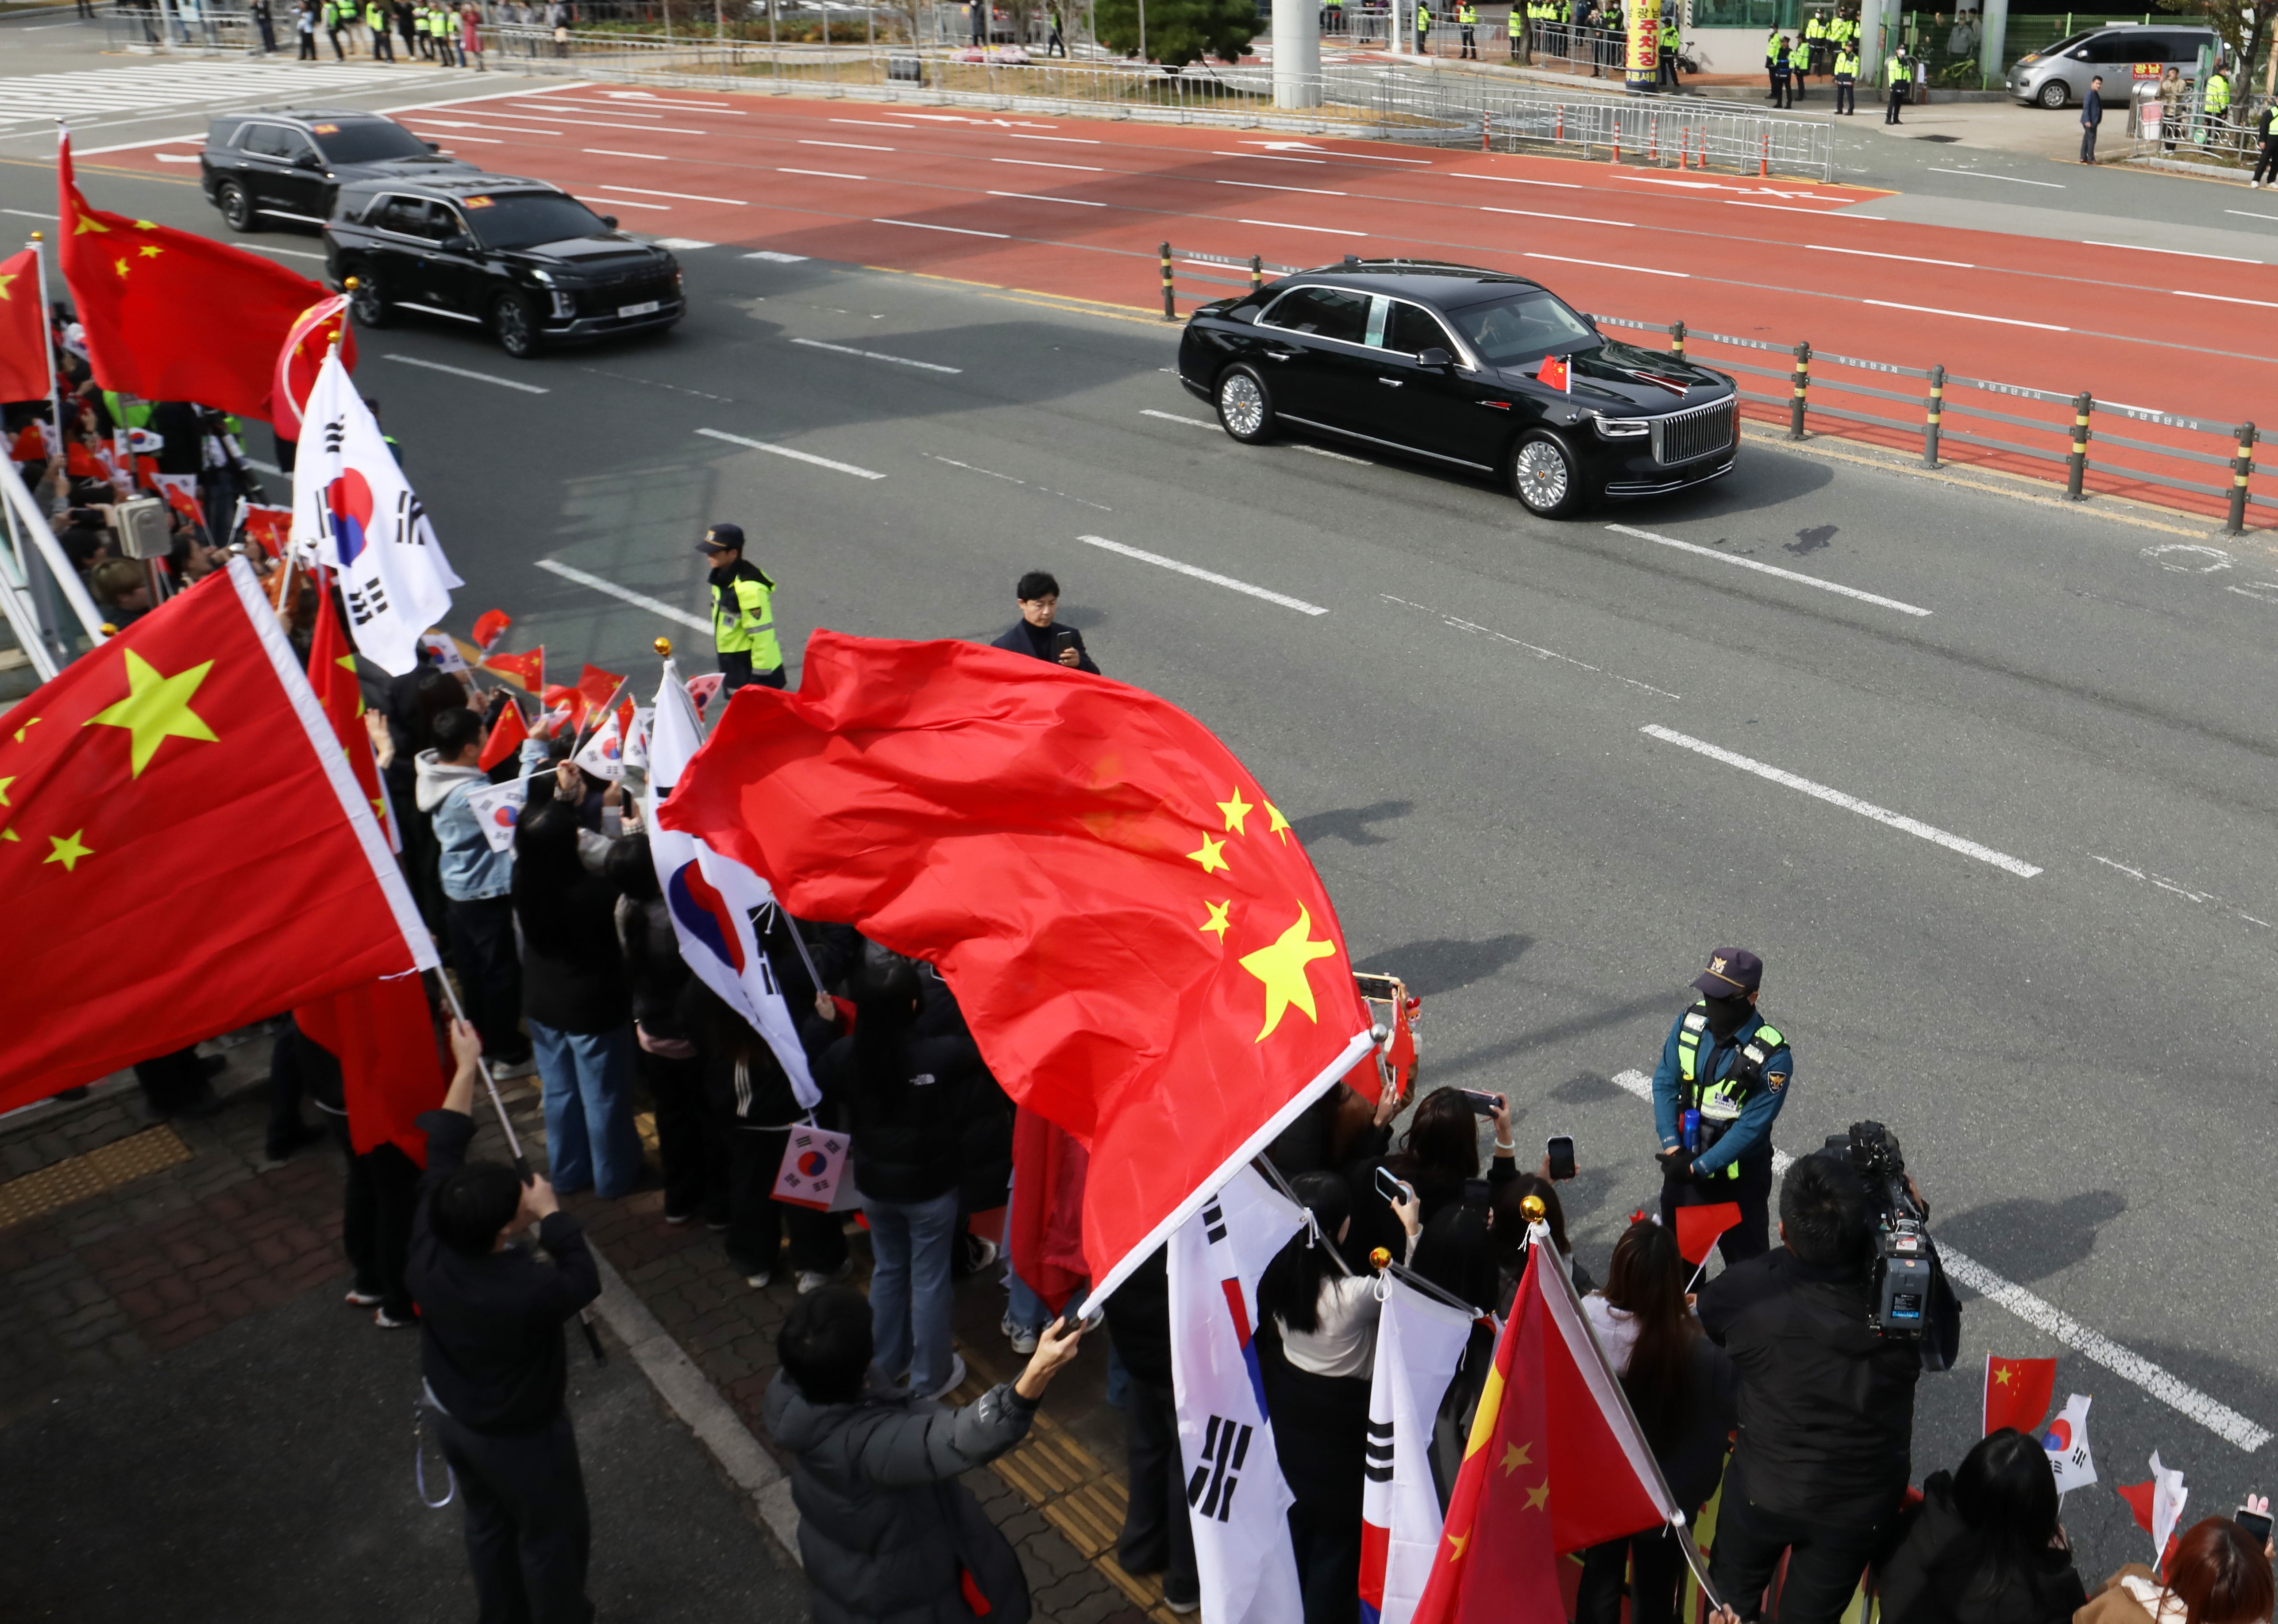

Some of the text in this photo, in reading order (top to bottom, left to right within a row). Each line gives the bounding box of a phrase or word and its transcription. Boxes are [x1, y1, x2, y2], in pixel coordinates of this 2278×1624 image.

[1638, 19, 1657, 66] 주차장
[1978, 381, 2040, 400] 무단횡단금지
[2128, 410, 2197, 430] 무단횡단금지
